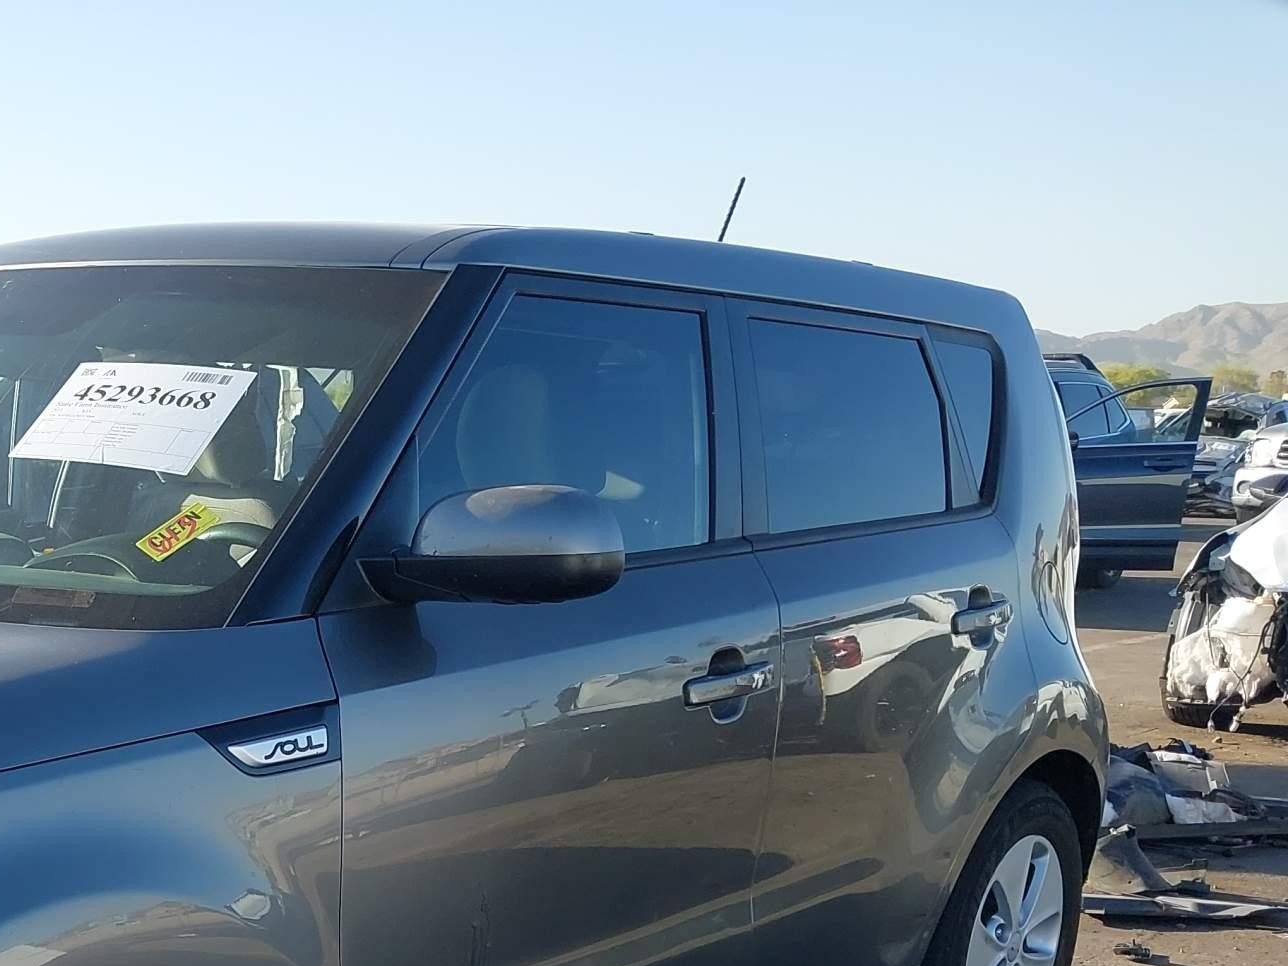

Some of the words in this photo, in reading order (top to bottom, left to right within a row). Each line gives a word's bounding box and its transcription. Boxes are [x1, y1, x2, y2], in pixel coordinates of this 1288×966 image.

[73, 384, 217, 410] 45293668
[151, 511, 202, 548] CLEAN
[264, 735, 324, 760] SOUL
